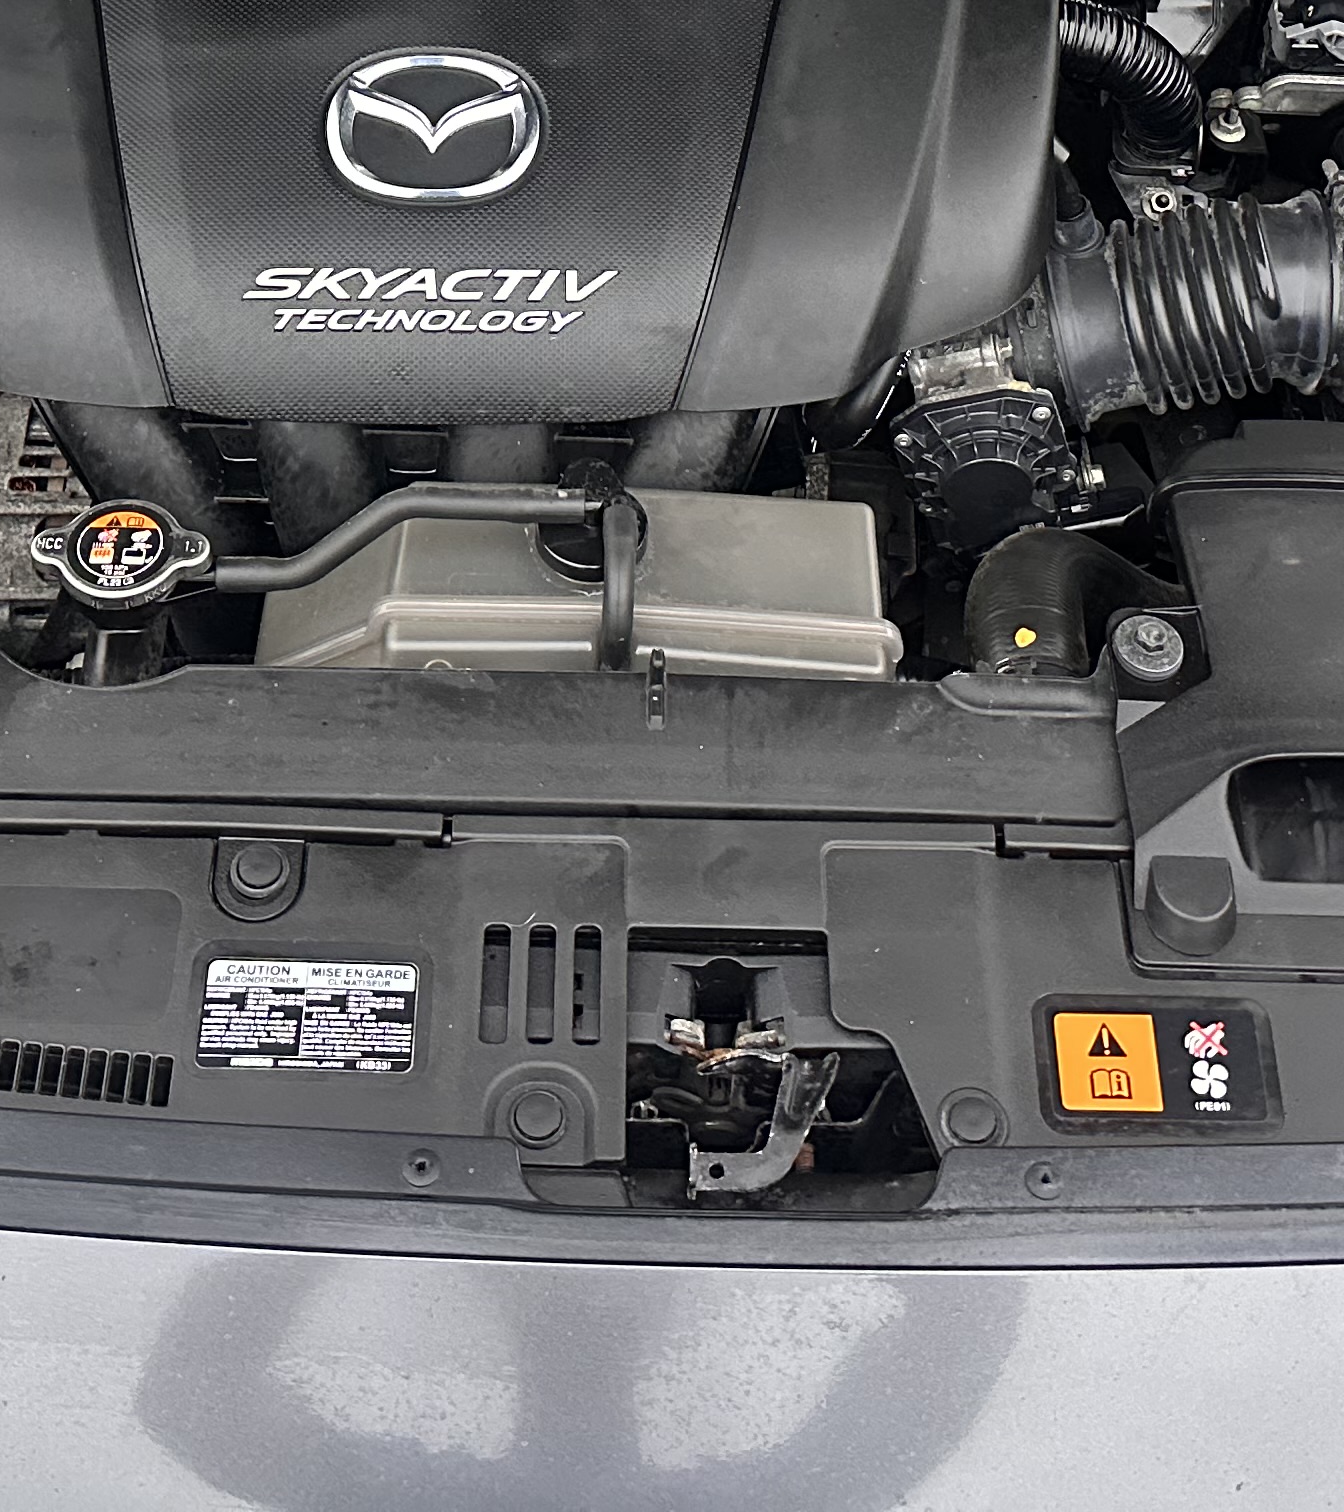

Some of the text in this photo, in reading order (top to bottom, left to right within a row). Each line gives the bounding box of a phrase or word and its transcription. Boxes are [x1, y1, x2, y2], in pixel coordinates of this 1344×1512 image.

[242, 267, 619, 302] SKYACTIV
[273, 308, 585, 333] TECHNOLOGY
[36, 537, 64, 550] HCC
[184, 540, 204, 553] 1.1
[227, 964, 291, 976] CAUTION
[311, 968, 411, 980] MISE EN GARDE
[233, 976, 299, 984] CONDITIONER
[327, 979, 391, 987] CLIMATISEUR
